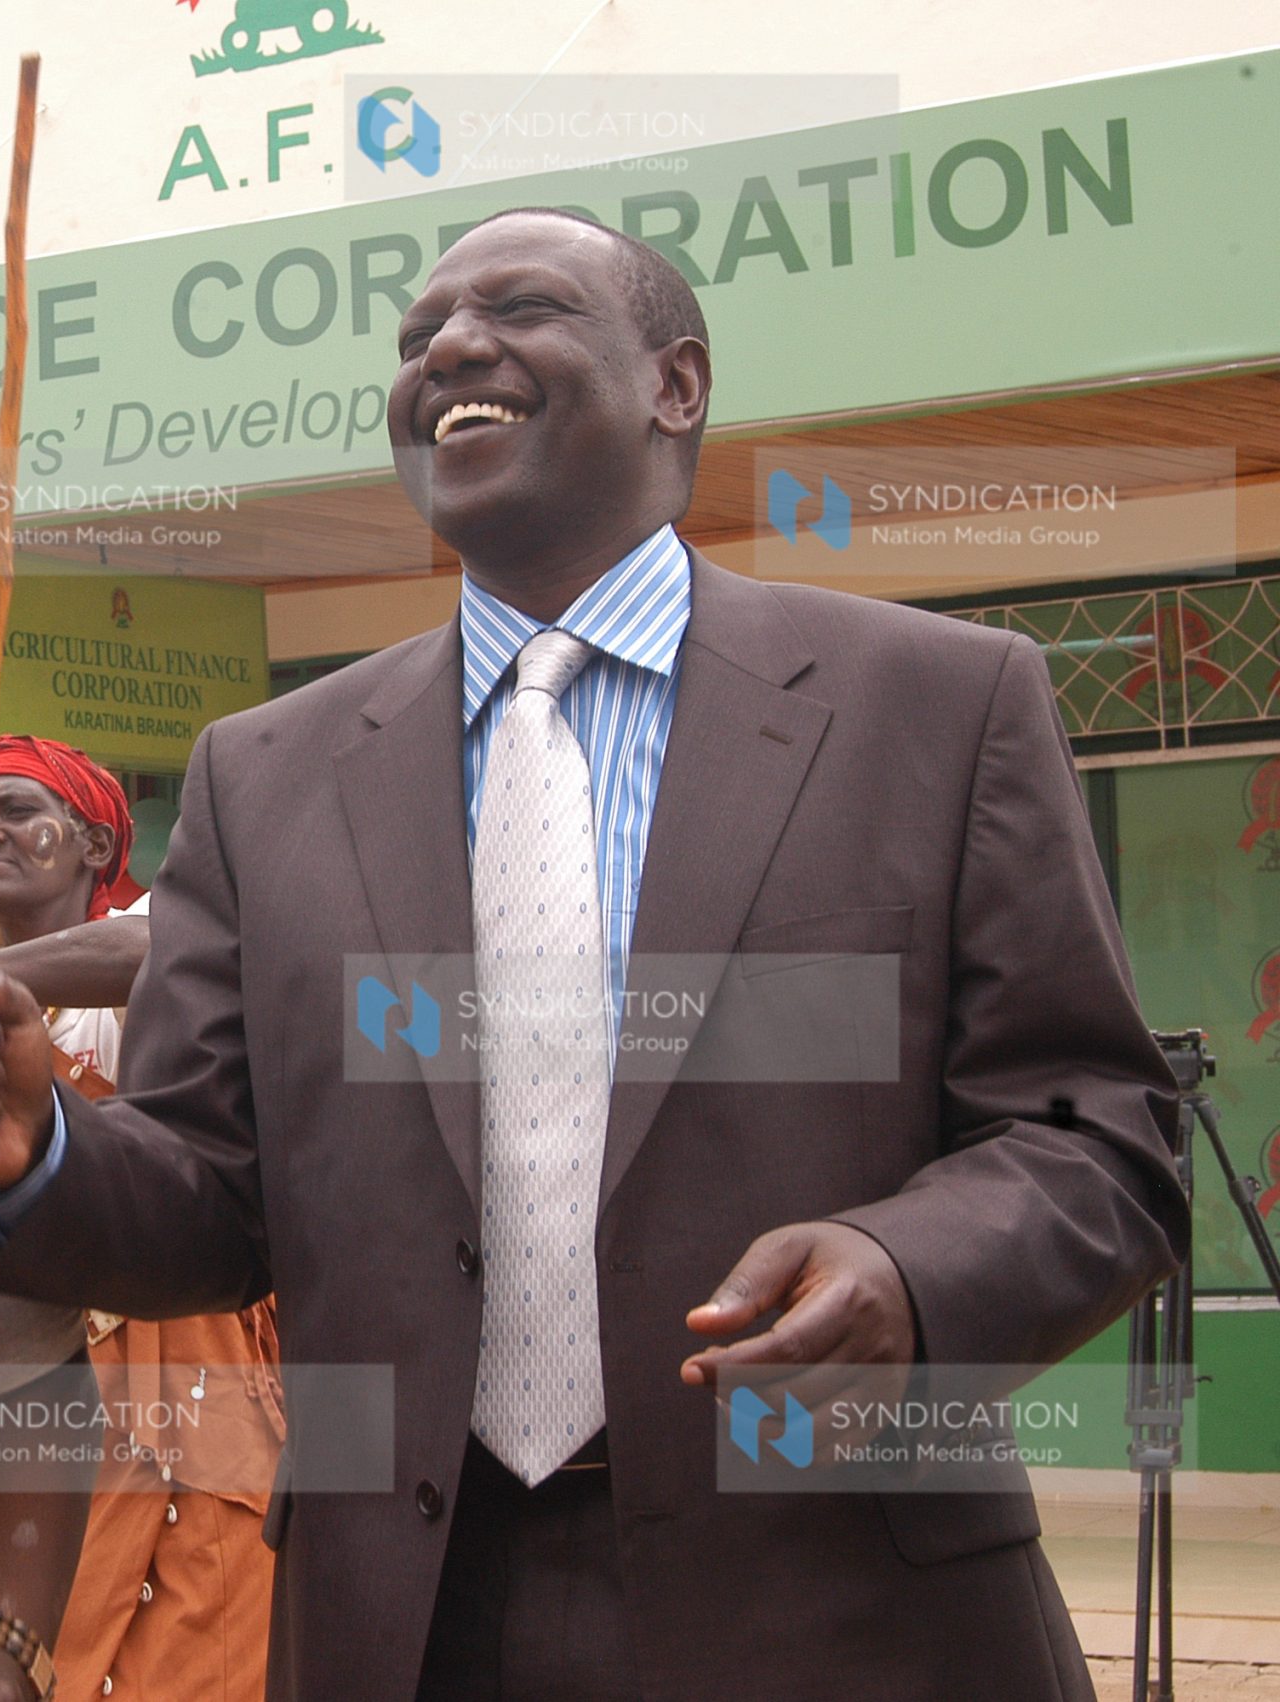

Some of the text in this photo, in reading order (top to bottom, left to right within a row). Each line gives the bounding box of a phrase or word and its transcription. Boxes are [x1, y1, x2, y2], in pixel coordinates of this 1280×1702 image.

[171, 117, 1135, 360] CORRATION
[166, 649, 251, 683] FINANCE
[52, 670, 203, 711] CORPORATION
[64, 709, 192, 739] KARATINA BRANCH
